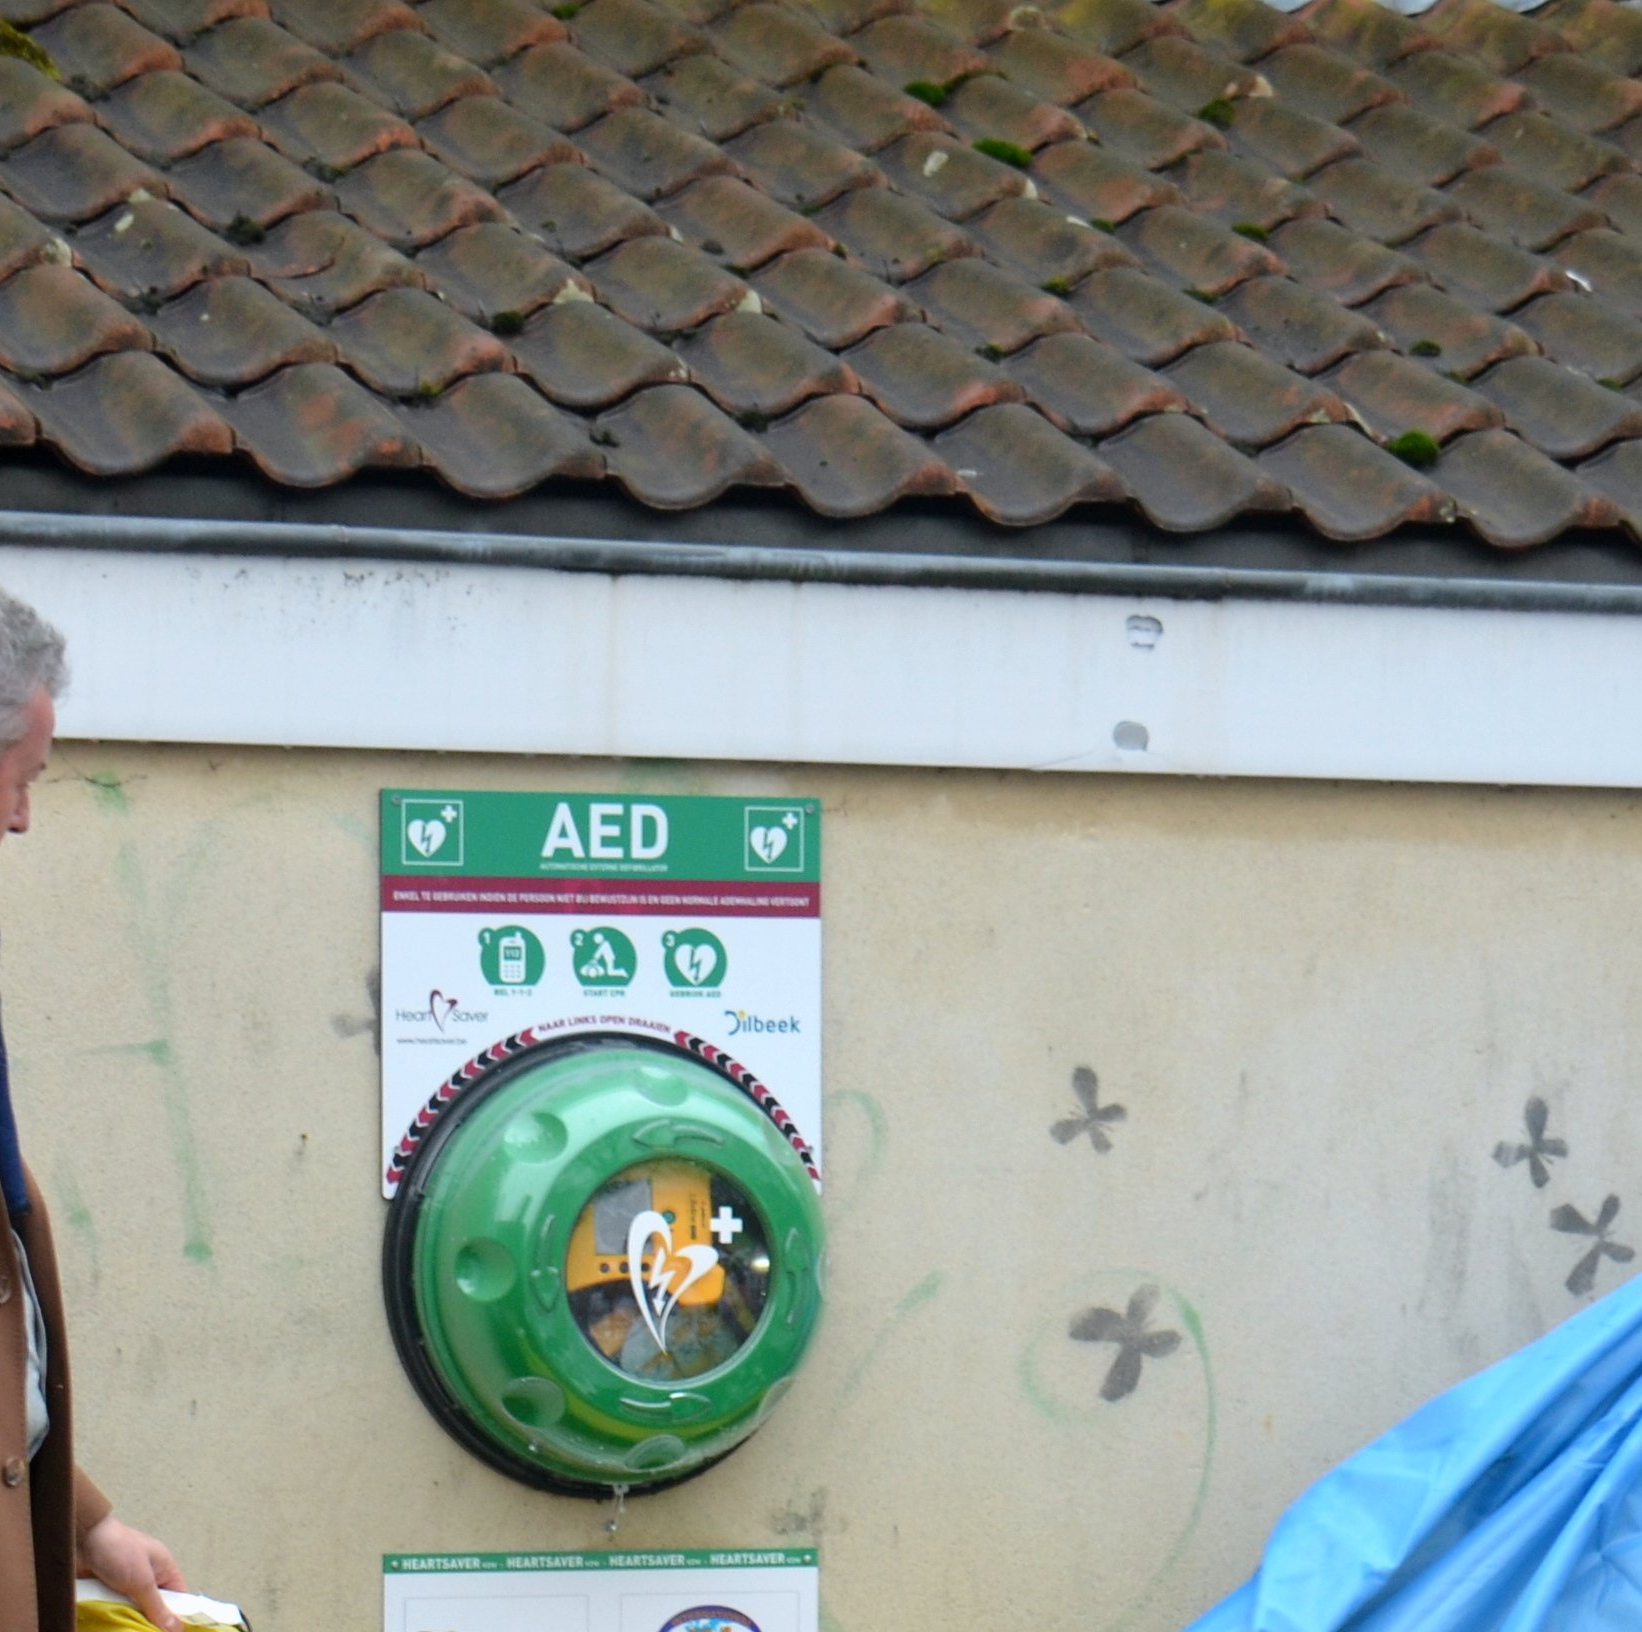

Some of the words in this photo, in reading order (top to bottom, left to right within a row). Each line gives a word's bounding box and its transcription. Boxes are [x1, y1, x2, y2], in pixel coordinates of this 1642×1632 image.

[540, 802, 668, 859] AED
[421, 890, 431, 901] TE
[507, 892, 517, 902] DE
[519, 892, 555, 903] PERSOON
[556, 893, 574, 903] NIET
[483, 932, 491, 944] 1
[574, 932, 584, 945] 2
[665, 933, 675, 946] 3
[452, 1010, 489, 1021] Saver
[538, 1018, 565, 1033] NAAR
[568, 1015, 597, 1026] LINKS
[600, 1014, 625, 1025] OPEN
[628, 1016, 671, 1033] DRAAIEN
[724, 1010, 800, 1036] Dilbeek
[402, 1557, 481, 1570] HEARTSAVER
[507, 1556, 583, 1569] HEARTSAVER
[609, 1554, 685, 1567] HEARTSAVER
[710, 1552, 785, 1566] HEARTSAVER
